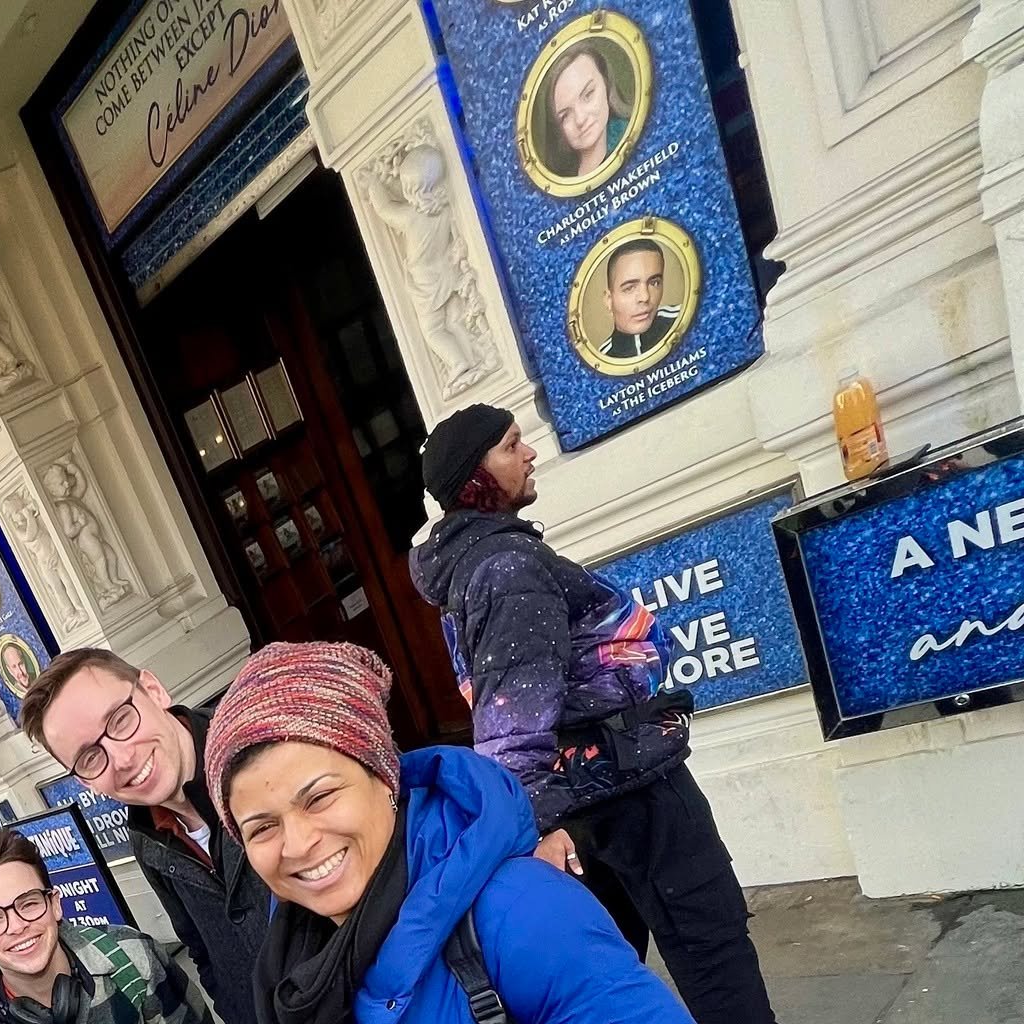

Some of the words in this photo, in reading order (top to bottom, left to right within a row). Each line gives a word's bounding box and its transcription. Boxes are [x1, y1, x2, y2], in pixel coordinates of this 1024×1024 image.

[175, 1, 226, 73] EXCEPT
[517, 4, 539, 32] KAT
[94, 16, 156, 105] NOTHING
[95, 84, 133, 136] COME
[130, 7, 191, 93] BETWEEN
[147, 62, 222, 167] Céline
[537, 191, 607, 244] CHARLOTTE
[607, 142, 679, 195] WAKEFIELD
[570, 204, 609, 239] MOLLY
[611, 170, 661, 210] BROWN
[599, 379, 645, 410] LAYTON
[646, 346, 707, 385] WILLIAMS
[621, 392, 646, 410] THE
[647, 365, 699, 398] ICEBERG
[890, 535, 935, 579] A
[947, 498, 1024, 559] NE
[631, 559, 724, 612] LIVE
[670, 612, 731, 652] VE
[909, 603, 1024, 661] an
[665, 637, 760, 689] ORE
[78, 789, 97, 808] BY
[92, 806, 129, 832] DROV
[96, 832, 115, 850] LL
[53, 878, 100, 898] ONIGHT
[74, 900, 87, 912] AT
